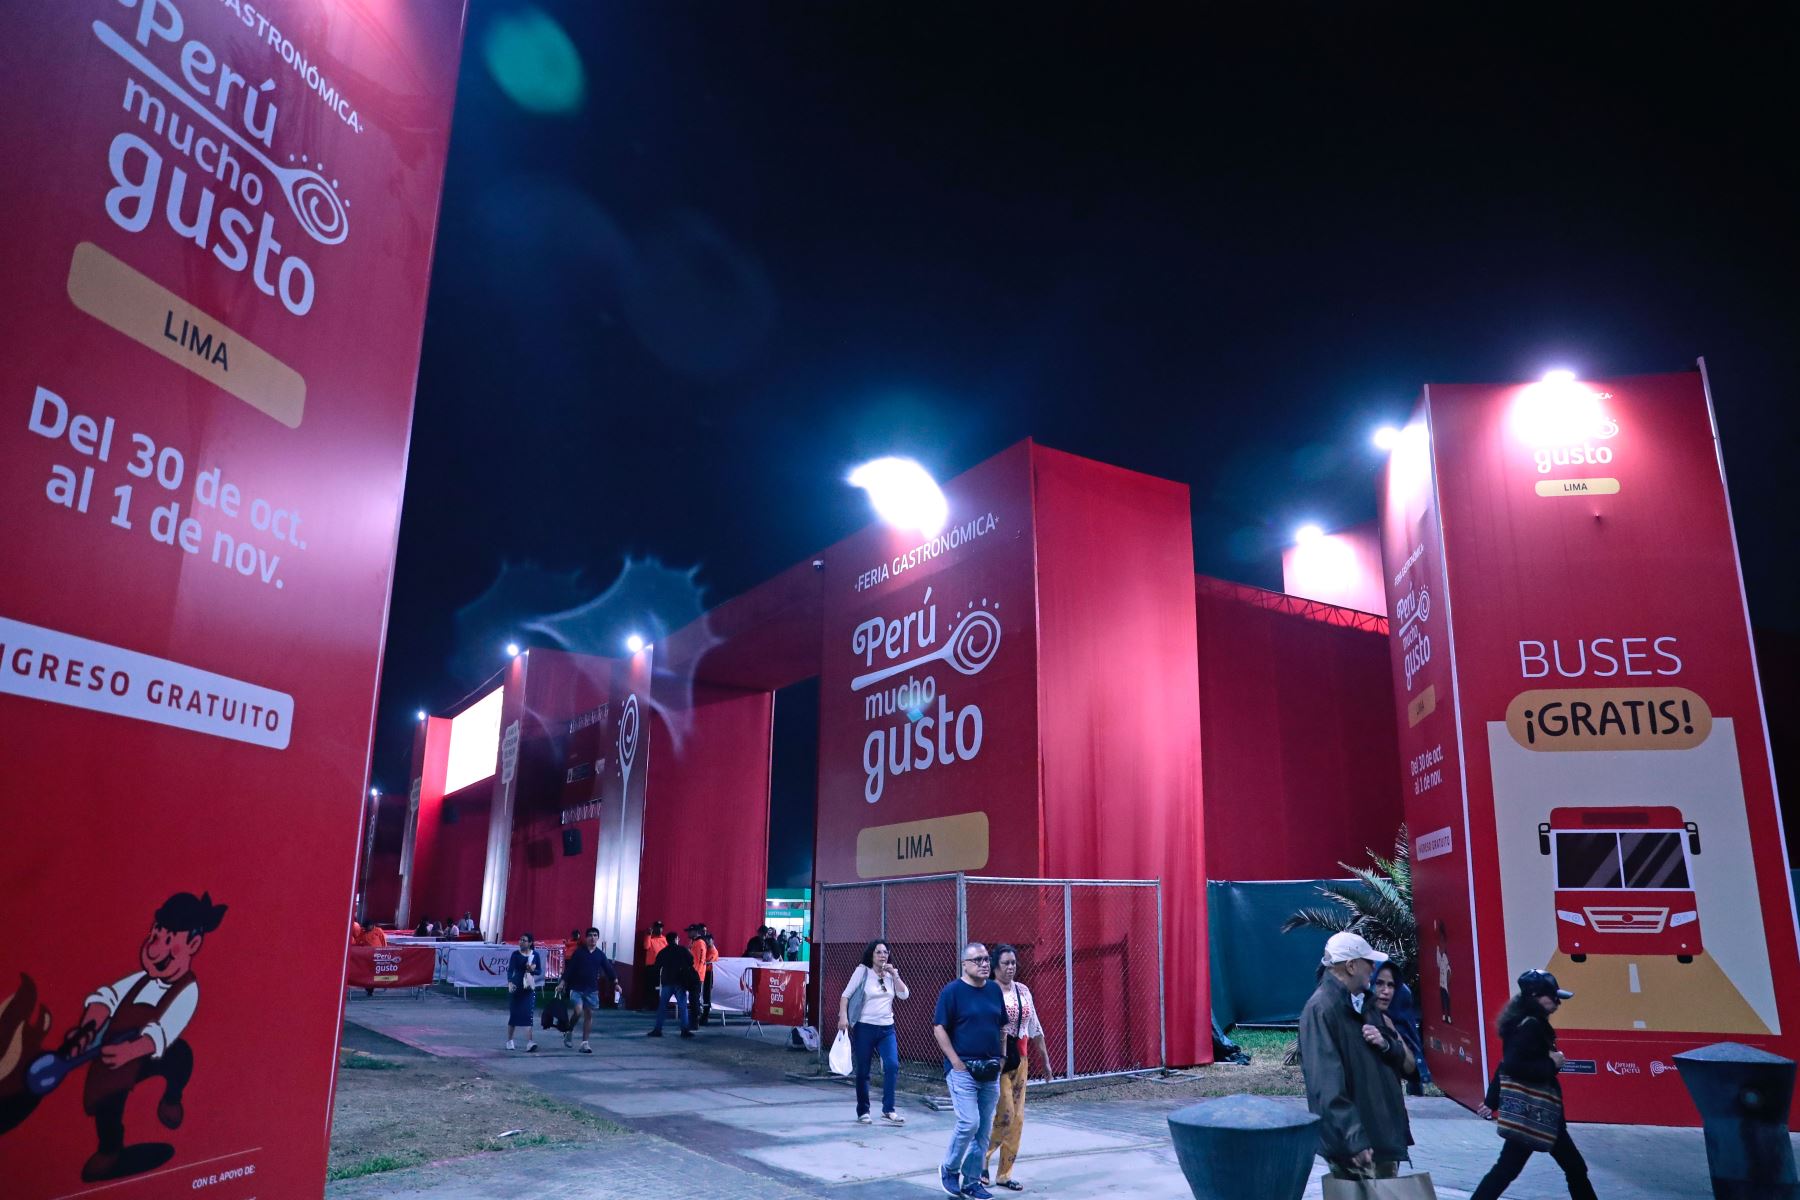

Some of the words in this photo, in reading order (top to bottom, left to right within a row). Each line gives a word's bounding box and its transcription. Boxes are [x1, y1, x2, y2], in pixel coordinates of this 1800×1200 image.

[115, 0, 278, 148] Perú
[222, 0, 360, 134] ASTRONÓMICA
[123, 78, 263, 206] mucho
[104, 132, 315, 316] gusto
[164, 310, 229, 372] LIMA
[28, 386, 115, 462] Del
[126, 433, 185, 490] 30
[195, 468, 241, 517] de
[249, 498, 308, 550] oct.
[1534, 442, 1612, 474] gusto
[1564, 483, 1588, 491] LIMA
[46, 464, 95, 513] al
[111, 485, 133, 530] 1
[150, 502, 203, 555] de
[211, 530, 284, 589] nov.
[858, 563, 889, 592] FERIA
[892, 513, 996, 576] GASTRONÓMICA
[852, 586, 936, 667] Perú
[1405, 633, 1430, 691] gusto
[1519, 636, 1682, 678] BUSES
[146, 679, 280, 733] GRATUITO
[865, 675, 936, 721] mucho
[1524, 699, 1694, 744] ¡GRATIS!
[863, 694, 983, 804] gusto
[897, 833, 933, 860] LIMA
[375, 963, 398, 974] gusto
[489, 957, 509, 968] pro
[192, 1178, 207, 1189] CON
[209, 1175, 218, 1184] EL
[219, 1168, 243, 1181] APOYO
